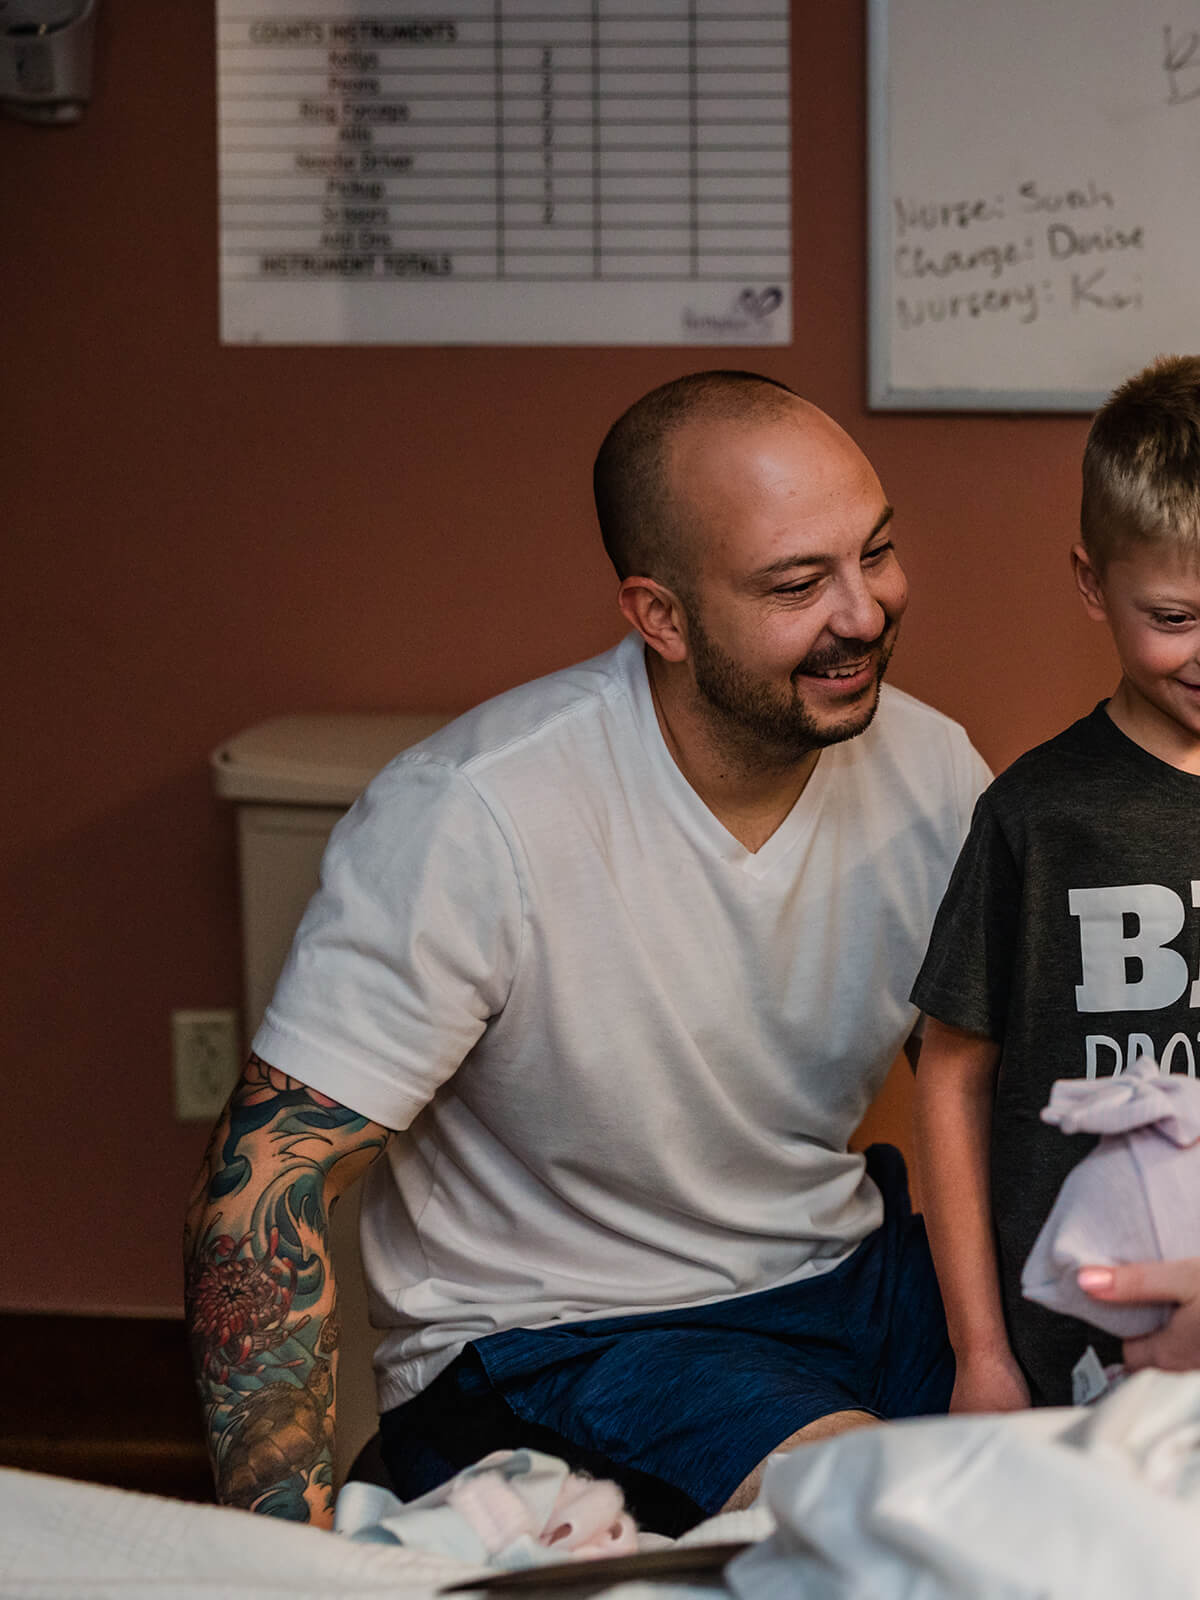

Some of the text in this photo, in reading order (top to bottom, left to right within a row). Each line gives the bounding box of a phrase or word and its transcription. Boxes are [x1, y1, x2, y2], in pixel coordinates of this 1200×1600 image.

[250, 22, 458, 43] COUNTS INSTRUMENTS
[260, 254, 452, 276] INSTRUMENT TOTALS
